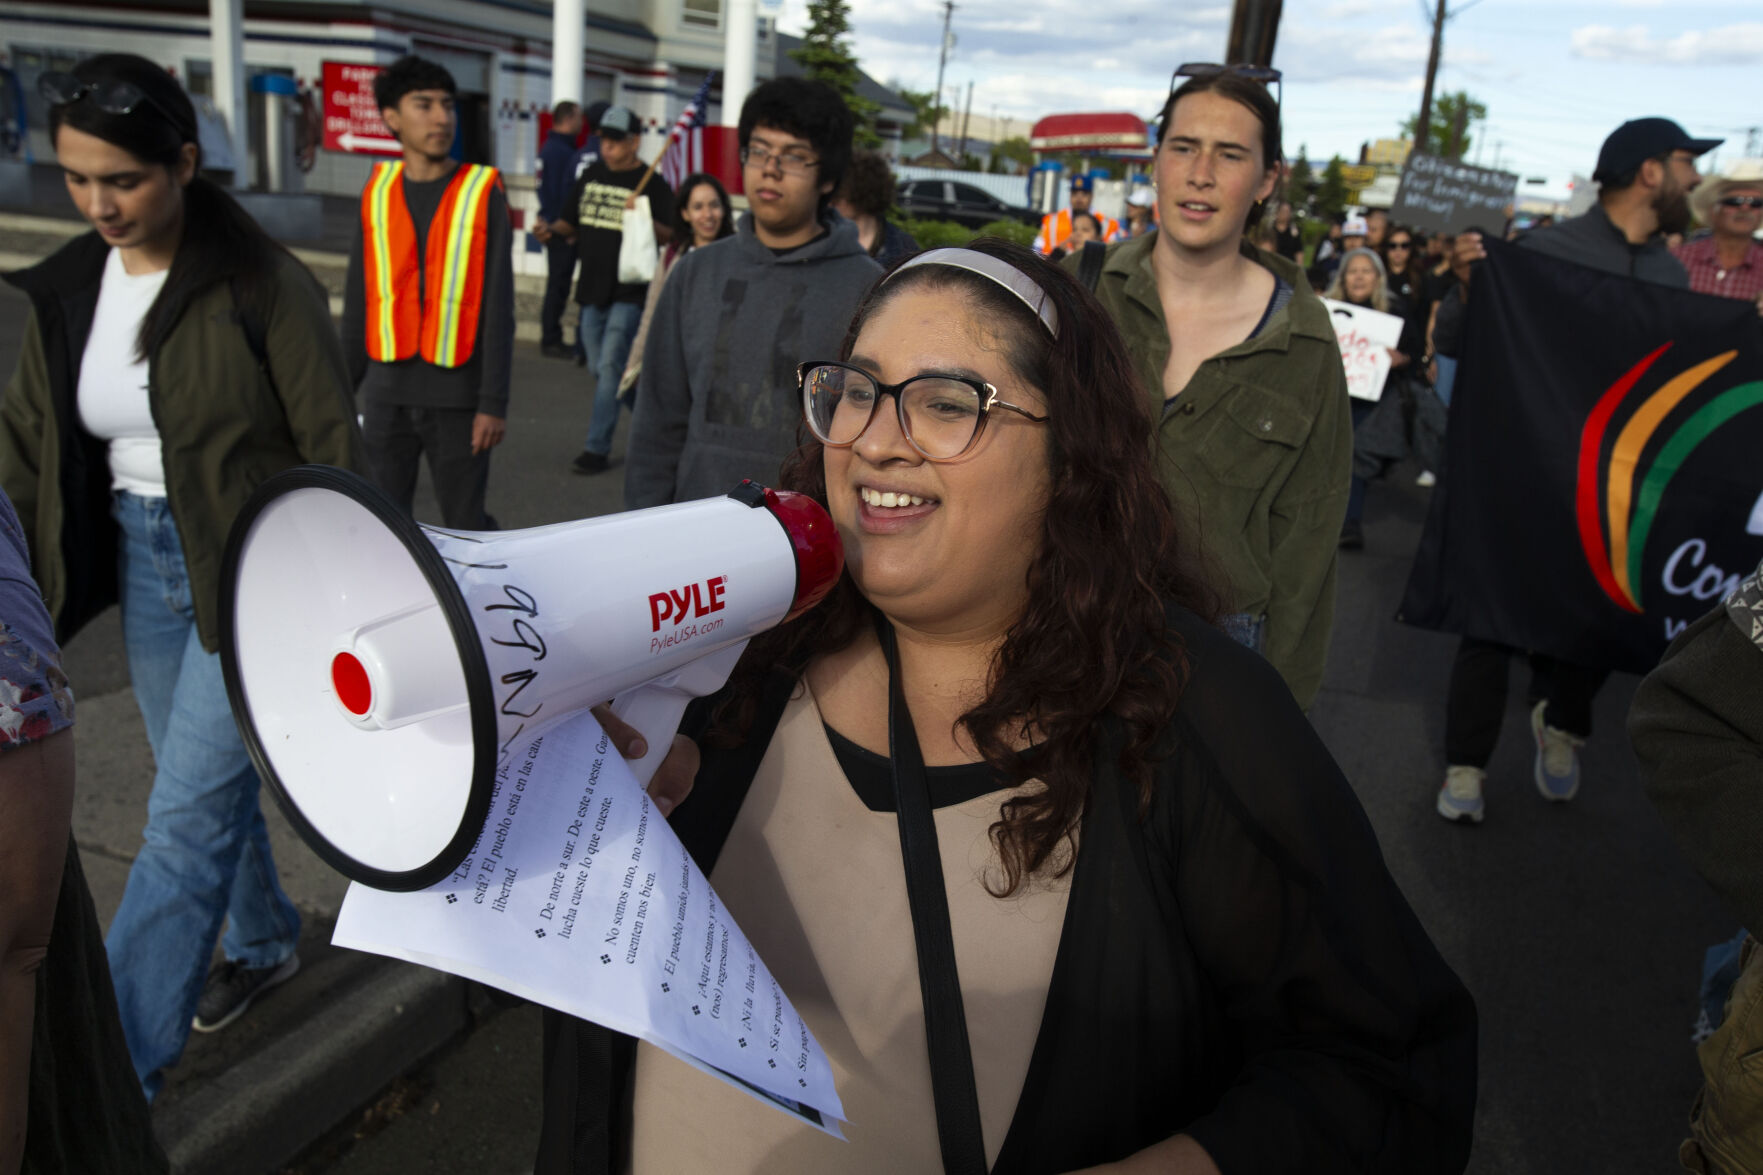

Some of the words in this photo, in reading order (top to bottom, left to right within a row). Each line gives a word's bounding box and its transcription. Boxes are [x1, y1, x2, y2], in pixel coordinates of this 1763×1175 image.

[648, 576, 725, 633] PYLE
[650, 618, 724, 656] PyleUSA.com
[518, 760, 535, 777] las
[588, 758, 604, 786] oeste.
[515, 778, 528, 792] en
[585, 787, 594, 795] a
[507, 792, 522, 817] está
[577, 795, 591, 818] este
[595, 796, 614, 832] cueste.
[491, 817, 513, 860] pueblo
[567, 819, 583, 838] De
[635, 812, 648, 847] somos
[562, 840, 577, 861] sur.
[586, 833, 601, 856] que
[631, 847, 642, 862] no
[481, 857, 497, 876] El
[560, 862, 569, 871] a
[579, 856, 593, 870] lo
[473, 873, 492, 905] está?
[491, 867, 518, 913] libertad.
[549, 871, 565, 902] norte
[571, 870, 589, 907] cueste
[622, 865, 639, 890] uno,
[638, 871, 657, 897] bien.
[539, 903, 556, 921] De
[614, 890, 629, 926] somos
[636, 898, 649, 919] nos
[557, 907, 578, 940] lucha
[664, 962, 676, 976] El
[670, 921, 684, 962] pueblo
[677, 891, 688, 922] unido
[605, 927, 620, 946] No
[625, 919, 644, 965] cuenten
[703, 920, 715, 963] estamos
[711, 987, 724, 1020] (nos)
[773, 1023, 781, 1038] se
